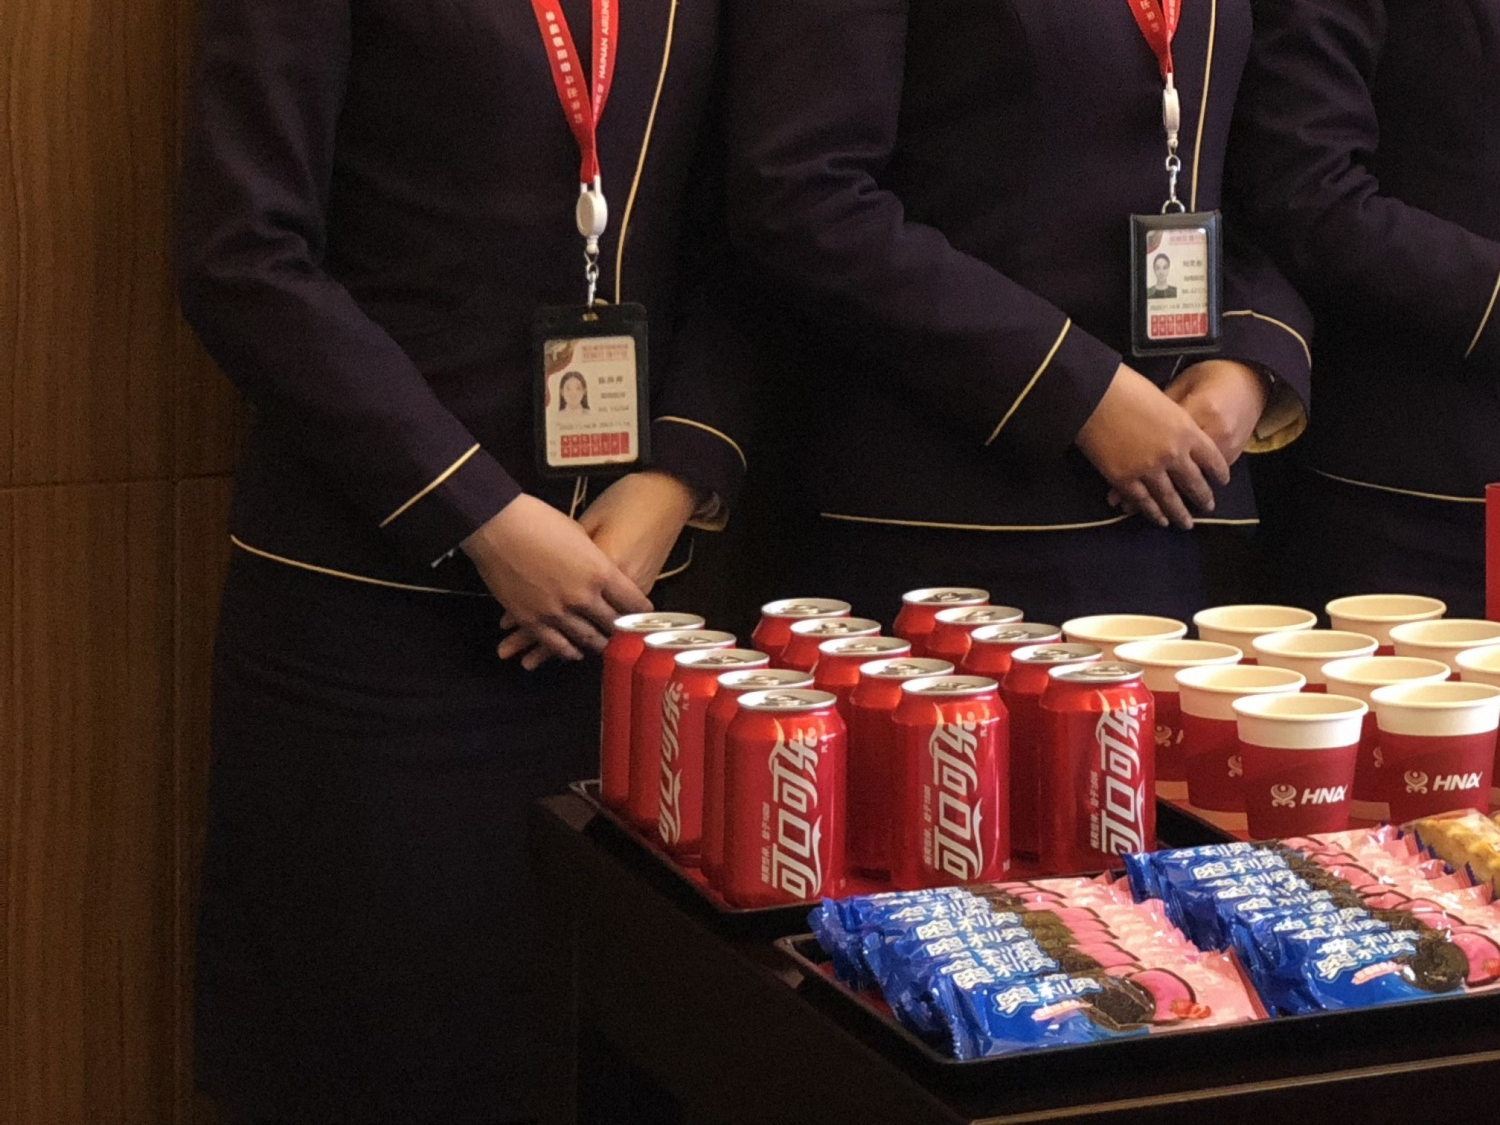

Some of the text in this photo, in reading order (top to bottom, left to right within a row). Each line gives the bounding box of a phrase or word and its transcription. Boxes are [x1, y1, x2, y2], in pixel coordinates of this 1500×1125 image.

[599, 37, 609, 78] HAINAN
[928, 702, 978, 880] 可口可乐
[1095, 690, 1141, 856] 可口可乐
[769, 717, 818, 899] 可口可乐
[953, 958, 1058, 990] 奥利奥
[1316, 942, 1416, 980] 奥利奥
[997, 977, 1102, 1014] 奥利奥
